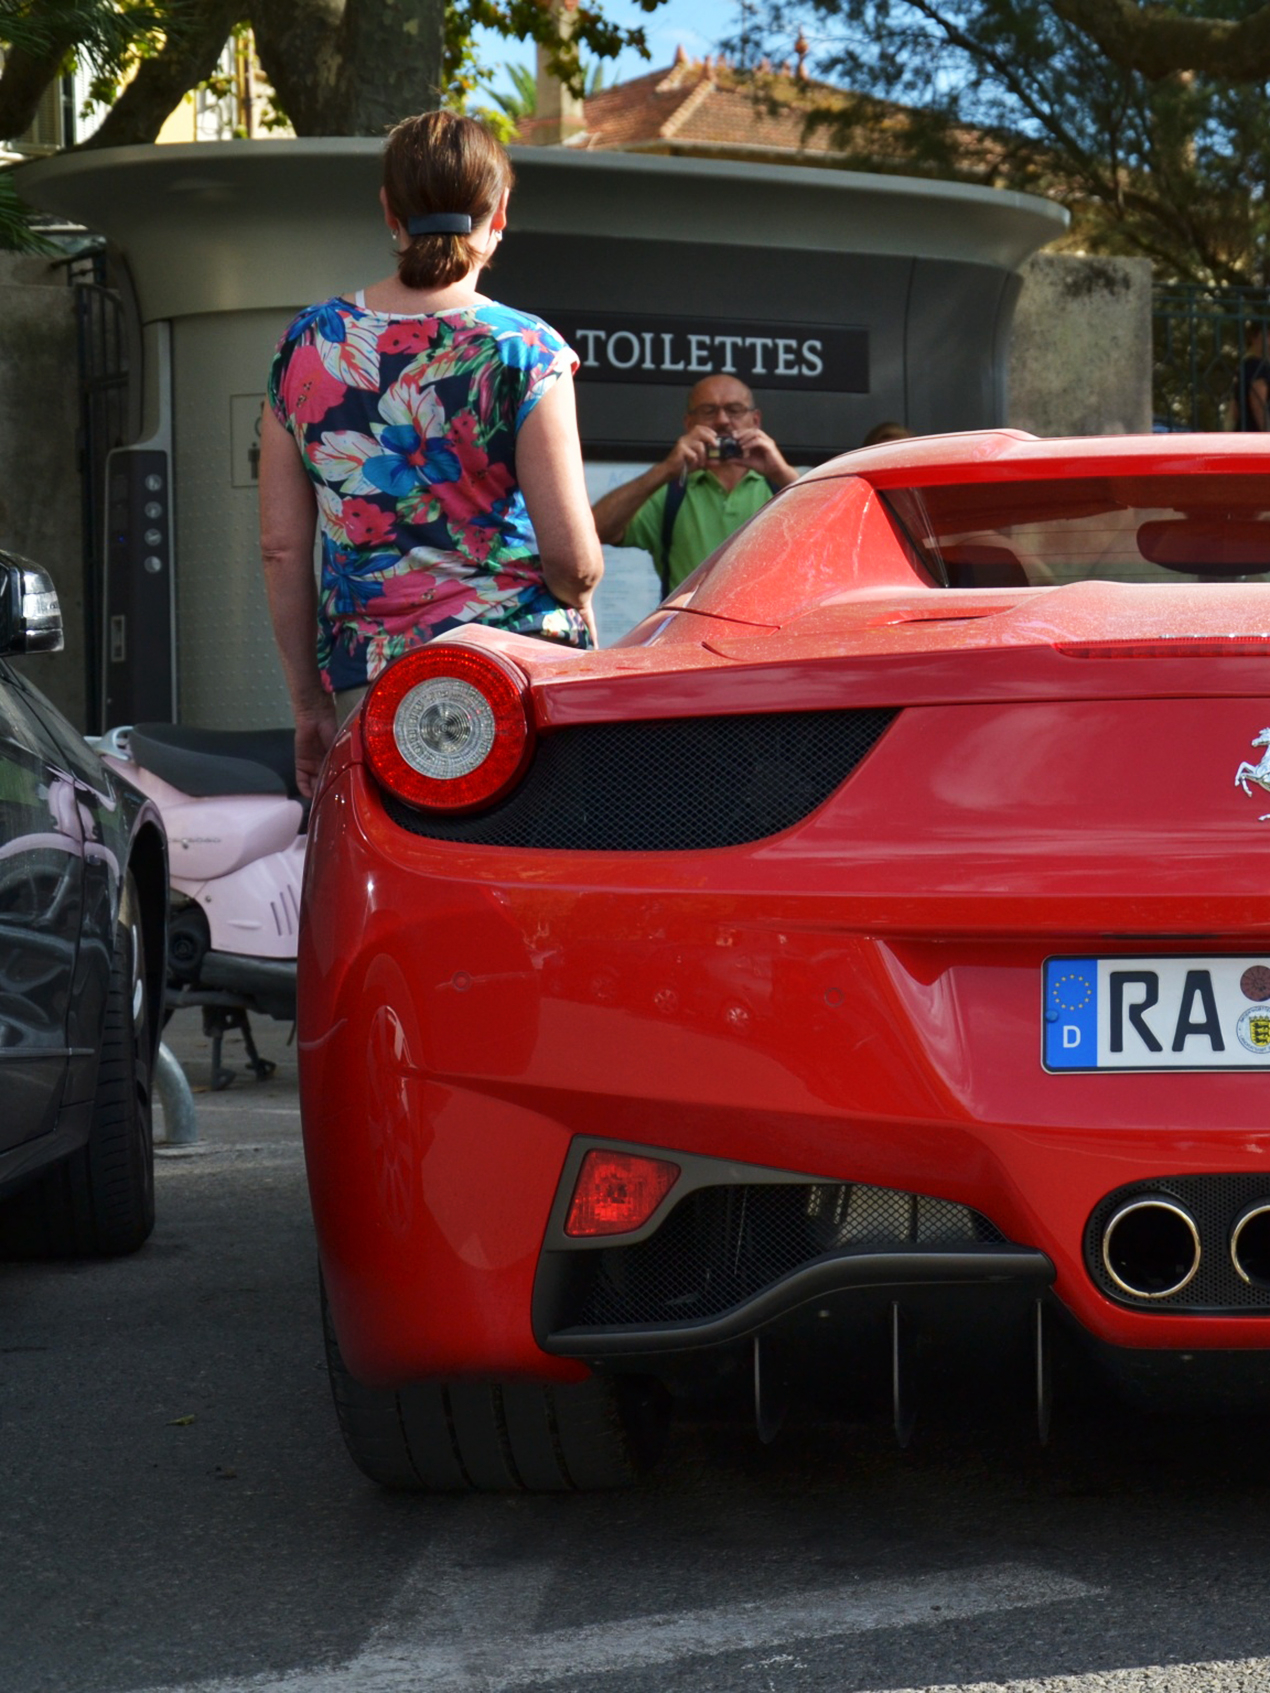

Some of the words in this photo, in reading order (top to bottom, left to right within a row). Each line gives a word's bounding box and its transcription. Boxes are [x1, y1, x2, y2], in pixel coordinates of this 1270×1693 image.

[576, 329, 823, 376] TOILETTES
[1109, 970, 1225, 1053] RA
[1062, 1025, 1081, 1048] D
